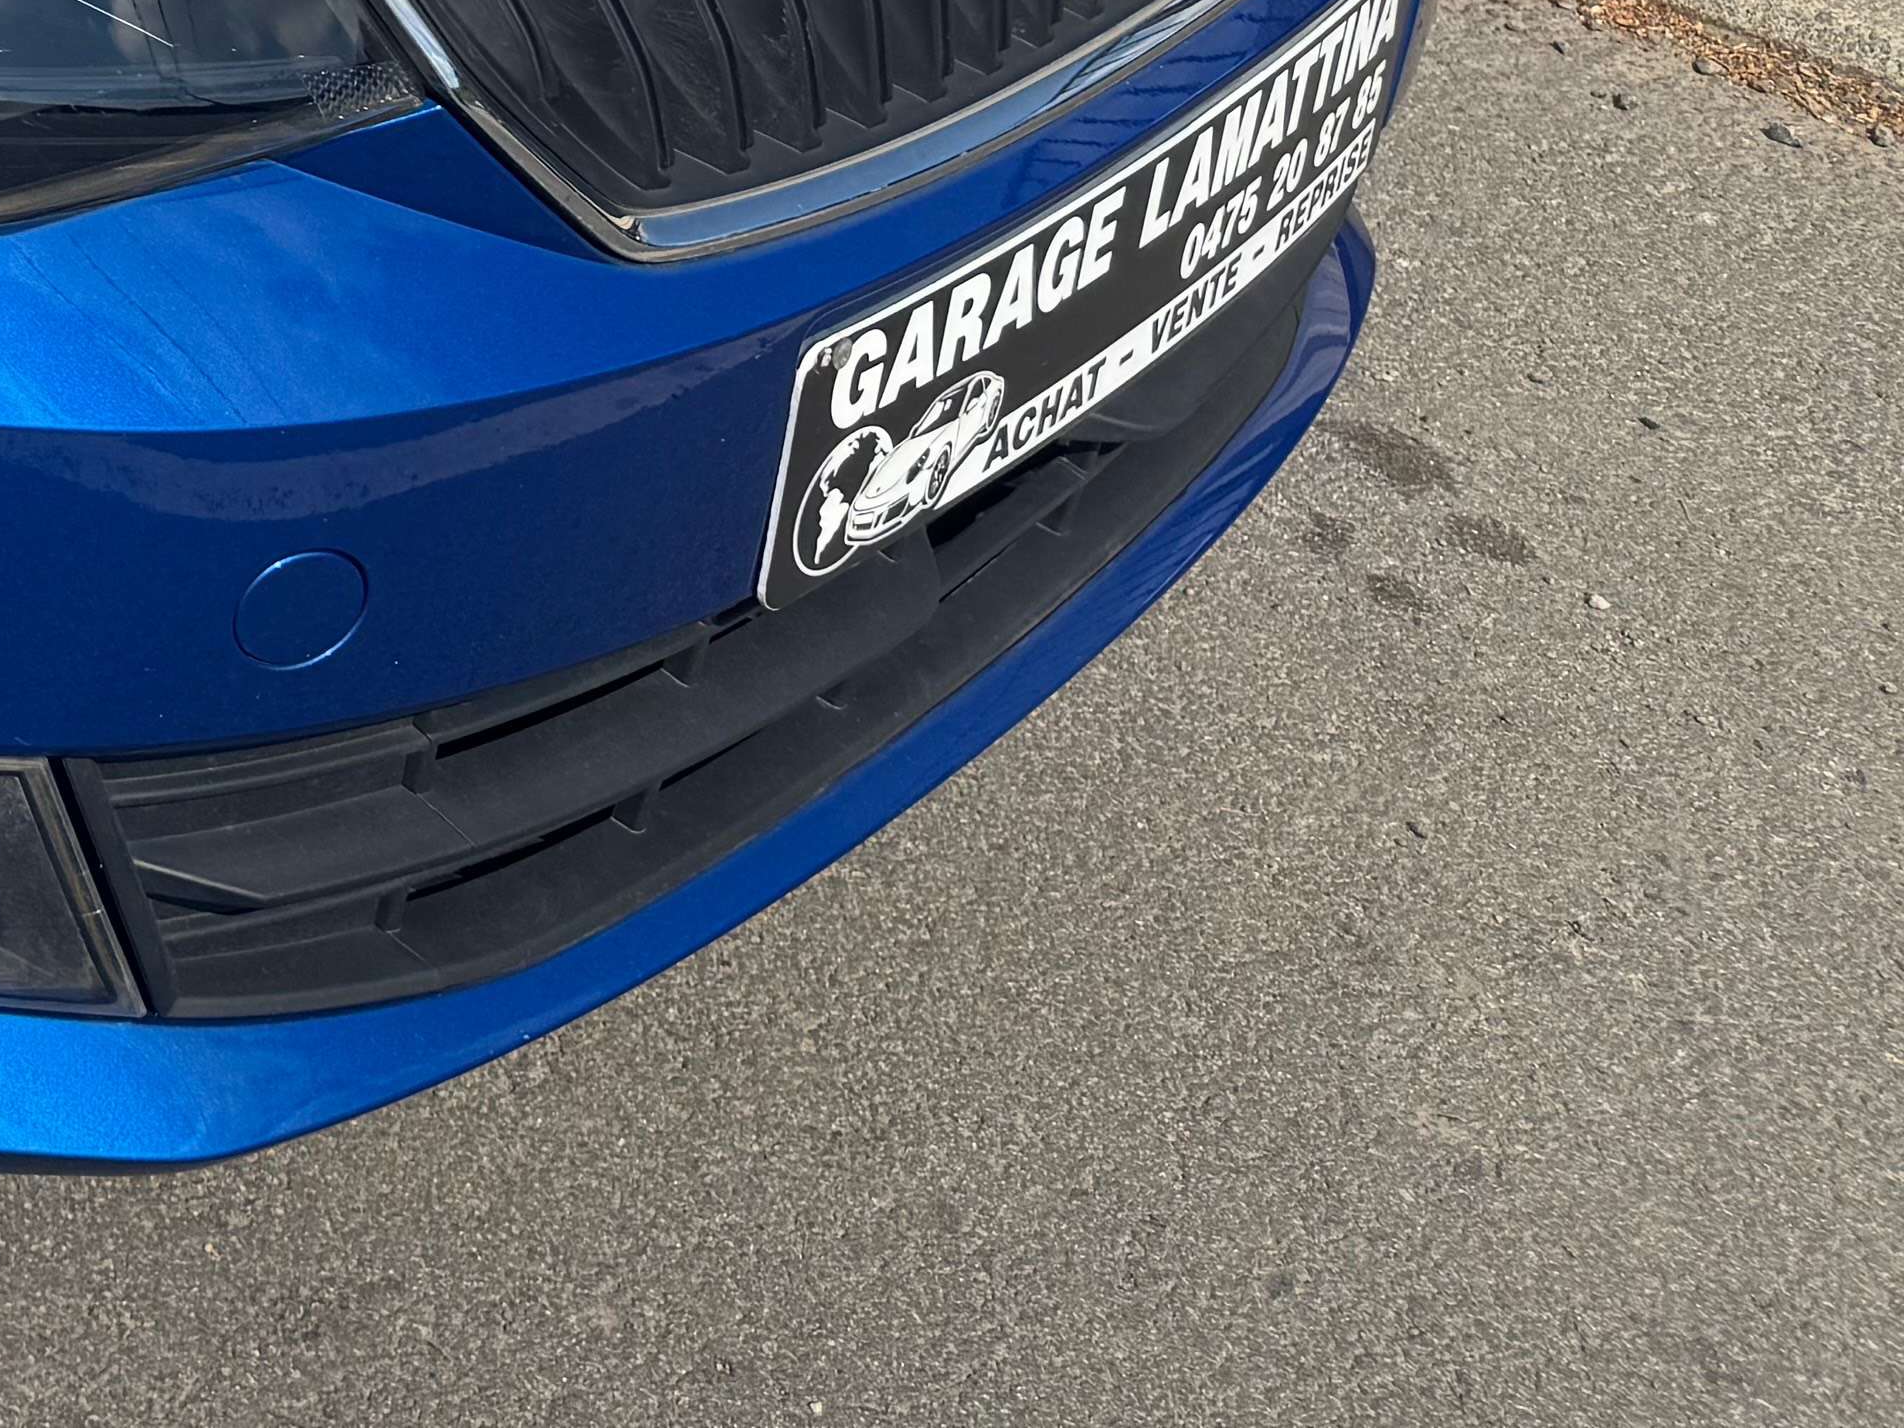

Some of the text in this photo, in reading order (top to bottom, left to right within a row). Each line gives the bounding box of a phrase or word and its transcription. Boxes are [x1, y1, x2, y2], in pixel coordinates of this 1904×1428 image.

[1179, 59, 1387, 280] 0475 20 87 85
[830, 186, 1127, 429] GARAGE
[982, 355, 1108, 473] ACHAT
[1151, 253, 1243, 346] VENTE
[1277, 132, 1373, 245] REPRISE
